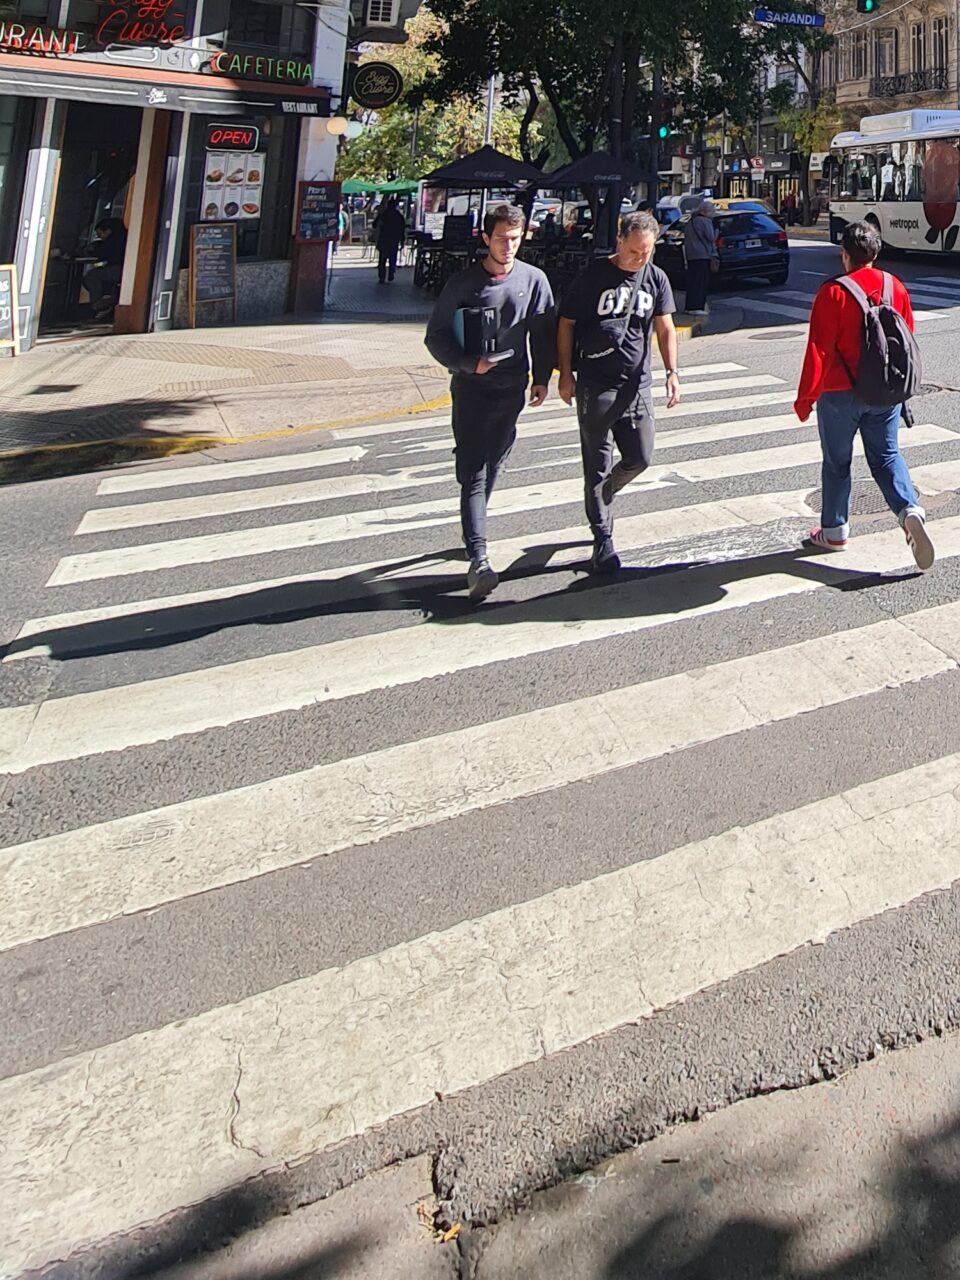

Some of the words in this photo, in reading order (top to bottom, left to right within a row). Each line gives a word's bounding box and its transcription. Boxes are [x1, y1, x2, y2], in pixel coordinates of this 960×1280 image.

[96, 9, 185, 44] Cuore
[765, 10, 816, 25] SARANDI
[215, 51, 313, 80] CAFETERIA
[210, 130, 253, 144] OPEN
[889, 219, 919, 231] Metropol
[597, 287, 653, 317] GAP
